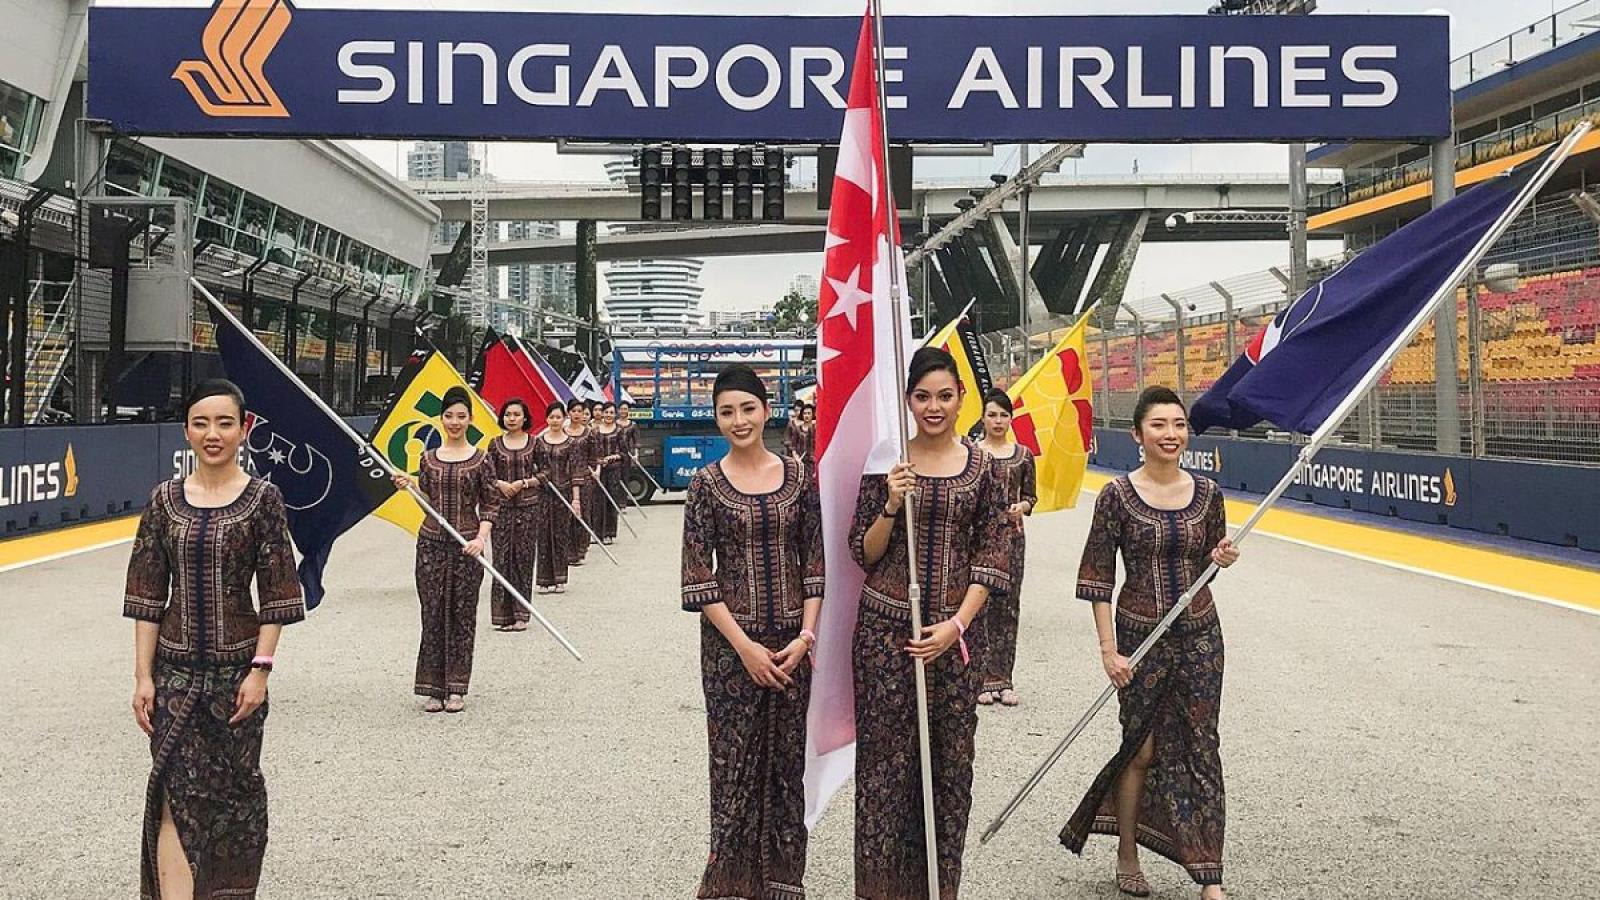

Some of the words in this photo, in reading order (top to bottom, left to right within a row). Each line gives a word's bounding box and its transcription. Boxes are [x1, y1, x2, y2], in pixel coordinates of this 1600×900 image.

[337, 40, 909, 111] SINGAPORE
[946, 45, 1399, 109] AIRLINES
[1371, 470, 1441, 504] AIRLINES
